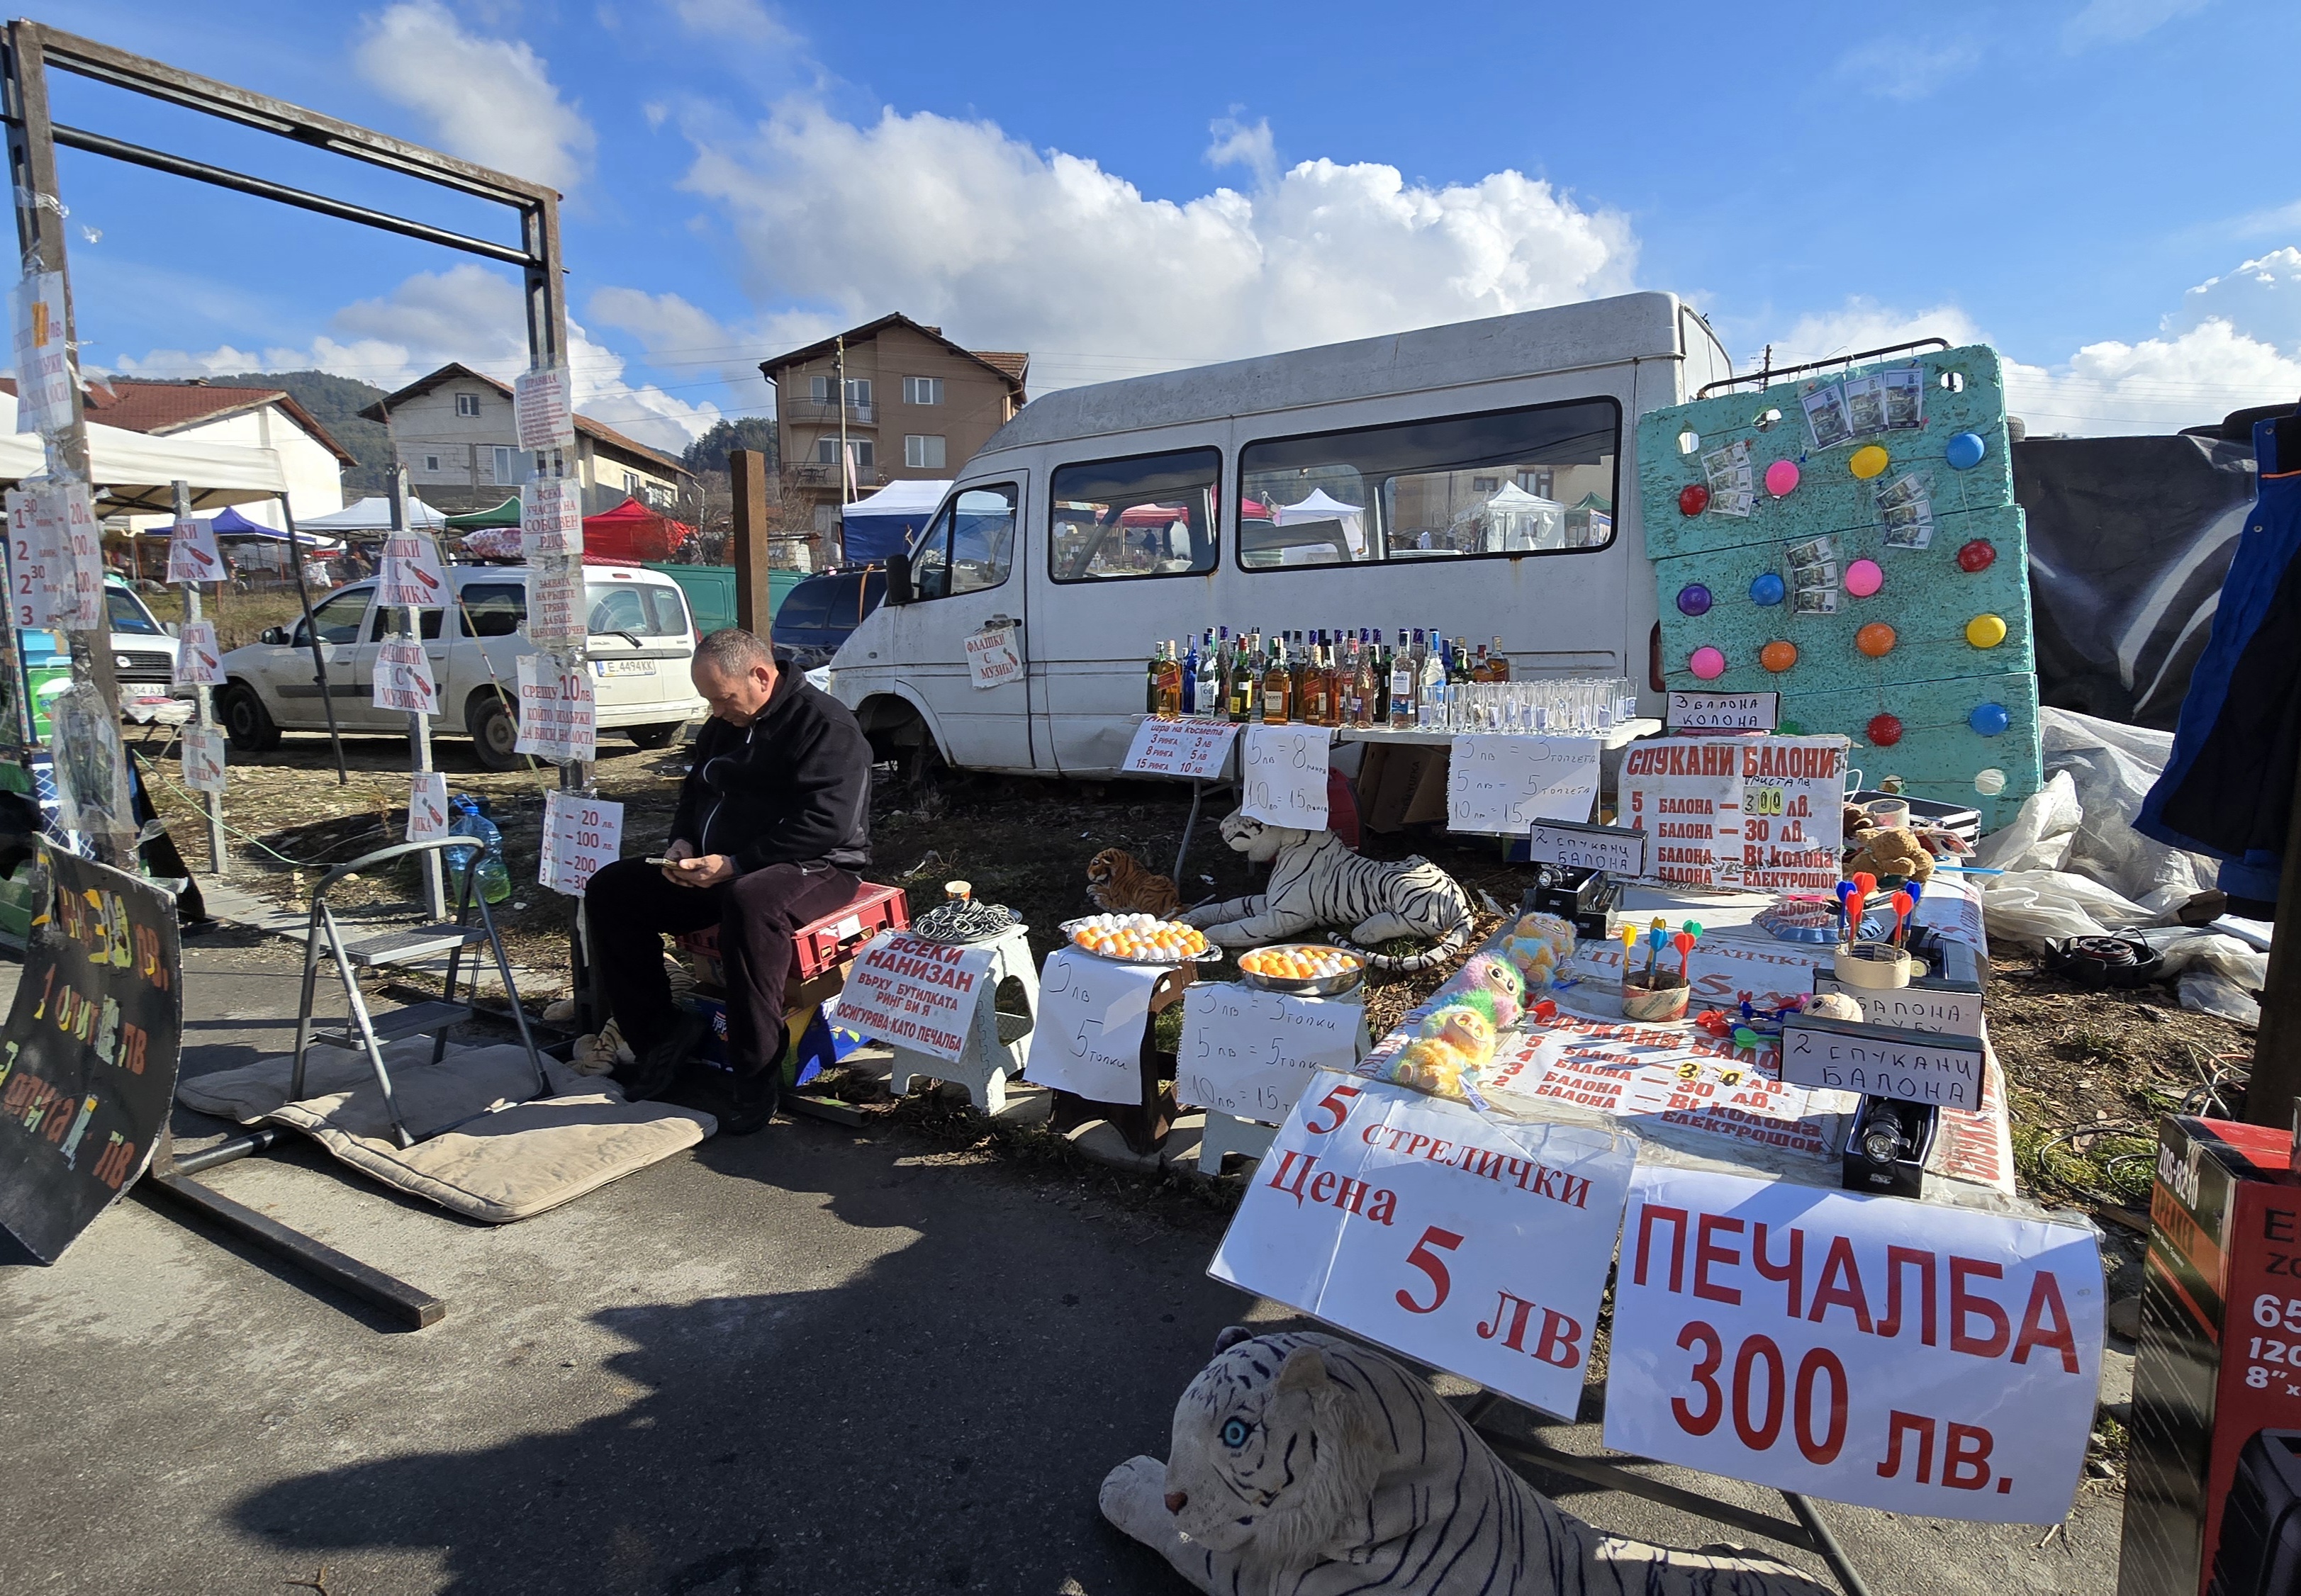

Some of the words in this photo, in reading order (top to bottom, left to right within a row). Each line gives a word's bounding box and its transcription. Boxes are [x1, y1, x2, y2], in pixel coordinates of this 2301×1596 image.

[524, 515, 578, 533] СОБСТВЕН
[539, 533, 568, 549] РИСК
[21, 605, 33, 625] 3
[967, 634, 1006, 653] ФЛАШКИ
[983, 652, 992, 663] С
[395, 668, 403, 685] С
[980, 663, 1014, 680] МУЗИКА
[522, 685, 559, 703] СРЕЩУ
[559, 674, 581, 701] 10
[527, 706, 554, 721] КОЙТО
[1674, 696, 1689, 709] 3
[1185, 727, 1224, 736] късмета
[1683, 714, 1758, 727] КОЛОНА
[1150, 734, 1158, 743] 3
[1158, 737, 1178, 746] РИНГА
[1195, 737, 1203, 747] 3
[1292, 734, 1306, 768] 8
[1136, 758, 1146, 769] 15
[1148, 762, 1169, 771] РИНГА
[1180, 763, 1192, 772] 10
[1146, 746, 1153, 755] 8
[1153, 749, 1174, 758] РИНГА
[1190, 750, 1197, 760] 5
[1627, 746, 1735, 776] СПУКАНИ
[1742, 746, 1836, 779] БАЛОНИ
[1455, 770, 1470, 792] 5
[1522, 775, 1540, 795] 5
[1289, 788, 1306, 809] 15
[1632, 791, 1642, 812] 5
[1658, 799, 1713, 814] БАЛОНА
[1786, 795, 1813, 817] лв.
[581, 810, 599, 826] 20
[1454, 800, 1470, 819] 10
[1504, 802, 1523, 823] 15
[576, 831, 600, 848] 100
[1535, 828, 1548, 844] 2
[1658, 823, 1713, 839] БАЛОНА
[1745, 819, 1769, 842] 30
[1781, 820, 1808, 843] лв.
[574, 855, 596, 873] 200
[1558, 851, 1628, 871] БАЛОНА
[1658, 847, 1713, 864] БАЛОНА
[1658, 866, 1713, 884] БАЛОНА
[1743, 870, 1837, 889] ЕЛЕКТРОШОК
[888, 938, 965, 966] ВСЕКИ
[864, 950, 975, 993] НАНИЗАН
[1048, 952, 1072, 994] 5
[858, 972, 893, 993] ВЪРХУ
[896, 983, 958, 1011] БУТИЛКАТА
[875, 992, 904, 1008] РИНГ
[904, 999, 920, 1013] ВИ
[921, 1004, 931, 1017] Я
[836, 1002, 890, 1028] ОСИГУРЯВА
[889, 1018, 916, 1038] КАТО
[917, 1025, 963, 1052] ПЕЧАЛБА
[1068, 1018, 1104, 1059] 5
[1197, 1027, 1211, 1059] 5
[1265, 1037, 1284, 1066] 5
[1525, 1035, 1546, 1047] 5
[1563, 1046, 1640, 1067] БАЛОНА
[1793, 1033, 1812, 1054] 2
[1502, 1062, 1525, 1076] 3
[1543, 1071, 1623, 1096] БАЛОНА
[1516, 1049, 1536, 1062] 4
[1554, 1059, 1633, 1081] БАЛОНА
[1676, 1079, 1715, 1098] 30
[1823, 1066, 1964, 1103] БАЛОНА
[1191, 1074, 1216, 1104] 10
[1256, 1085, 1279, 1111] 15
[1492, 1075, 1510, 1087] 2
[1535, 1084, 1617, 1109] БАЛОНА
[1660, 1110, 1824, 1154] ЕЛЕКТРОШОК
[1306, 1085, 1361, 1136] 5
[1360, 1121, 1595, 1212] СТРЕЛИЧКИ
[1266, 1149, 1400, 1229] Цена
[1394, 1224, 1466, 1315] 5
[1633, 1202, 2081, 1376] ПЕЧАЛБА
[1671, 1320, 1849, 1466] 300
